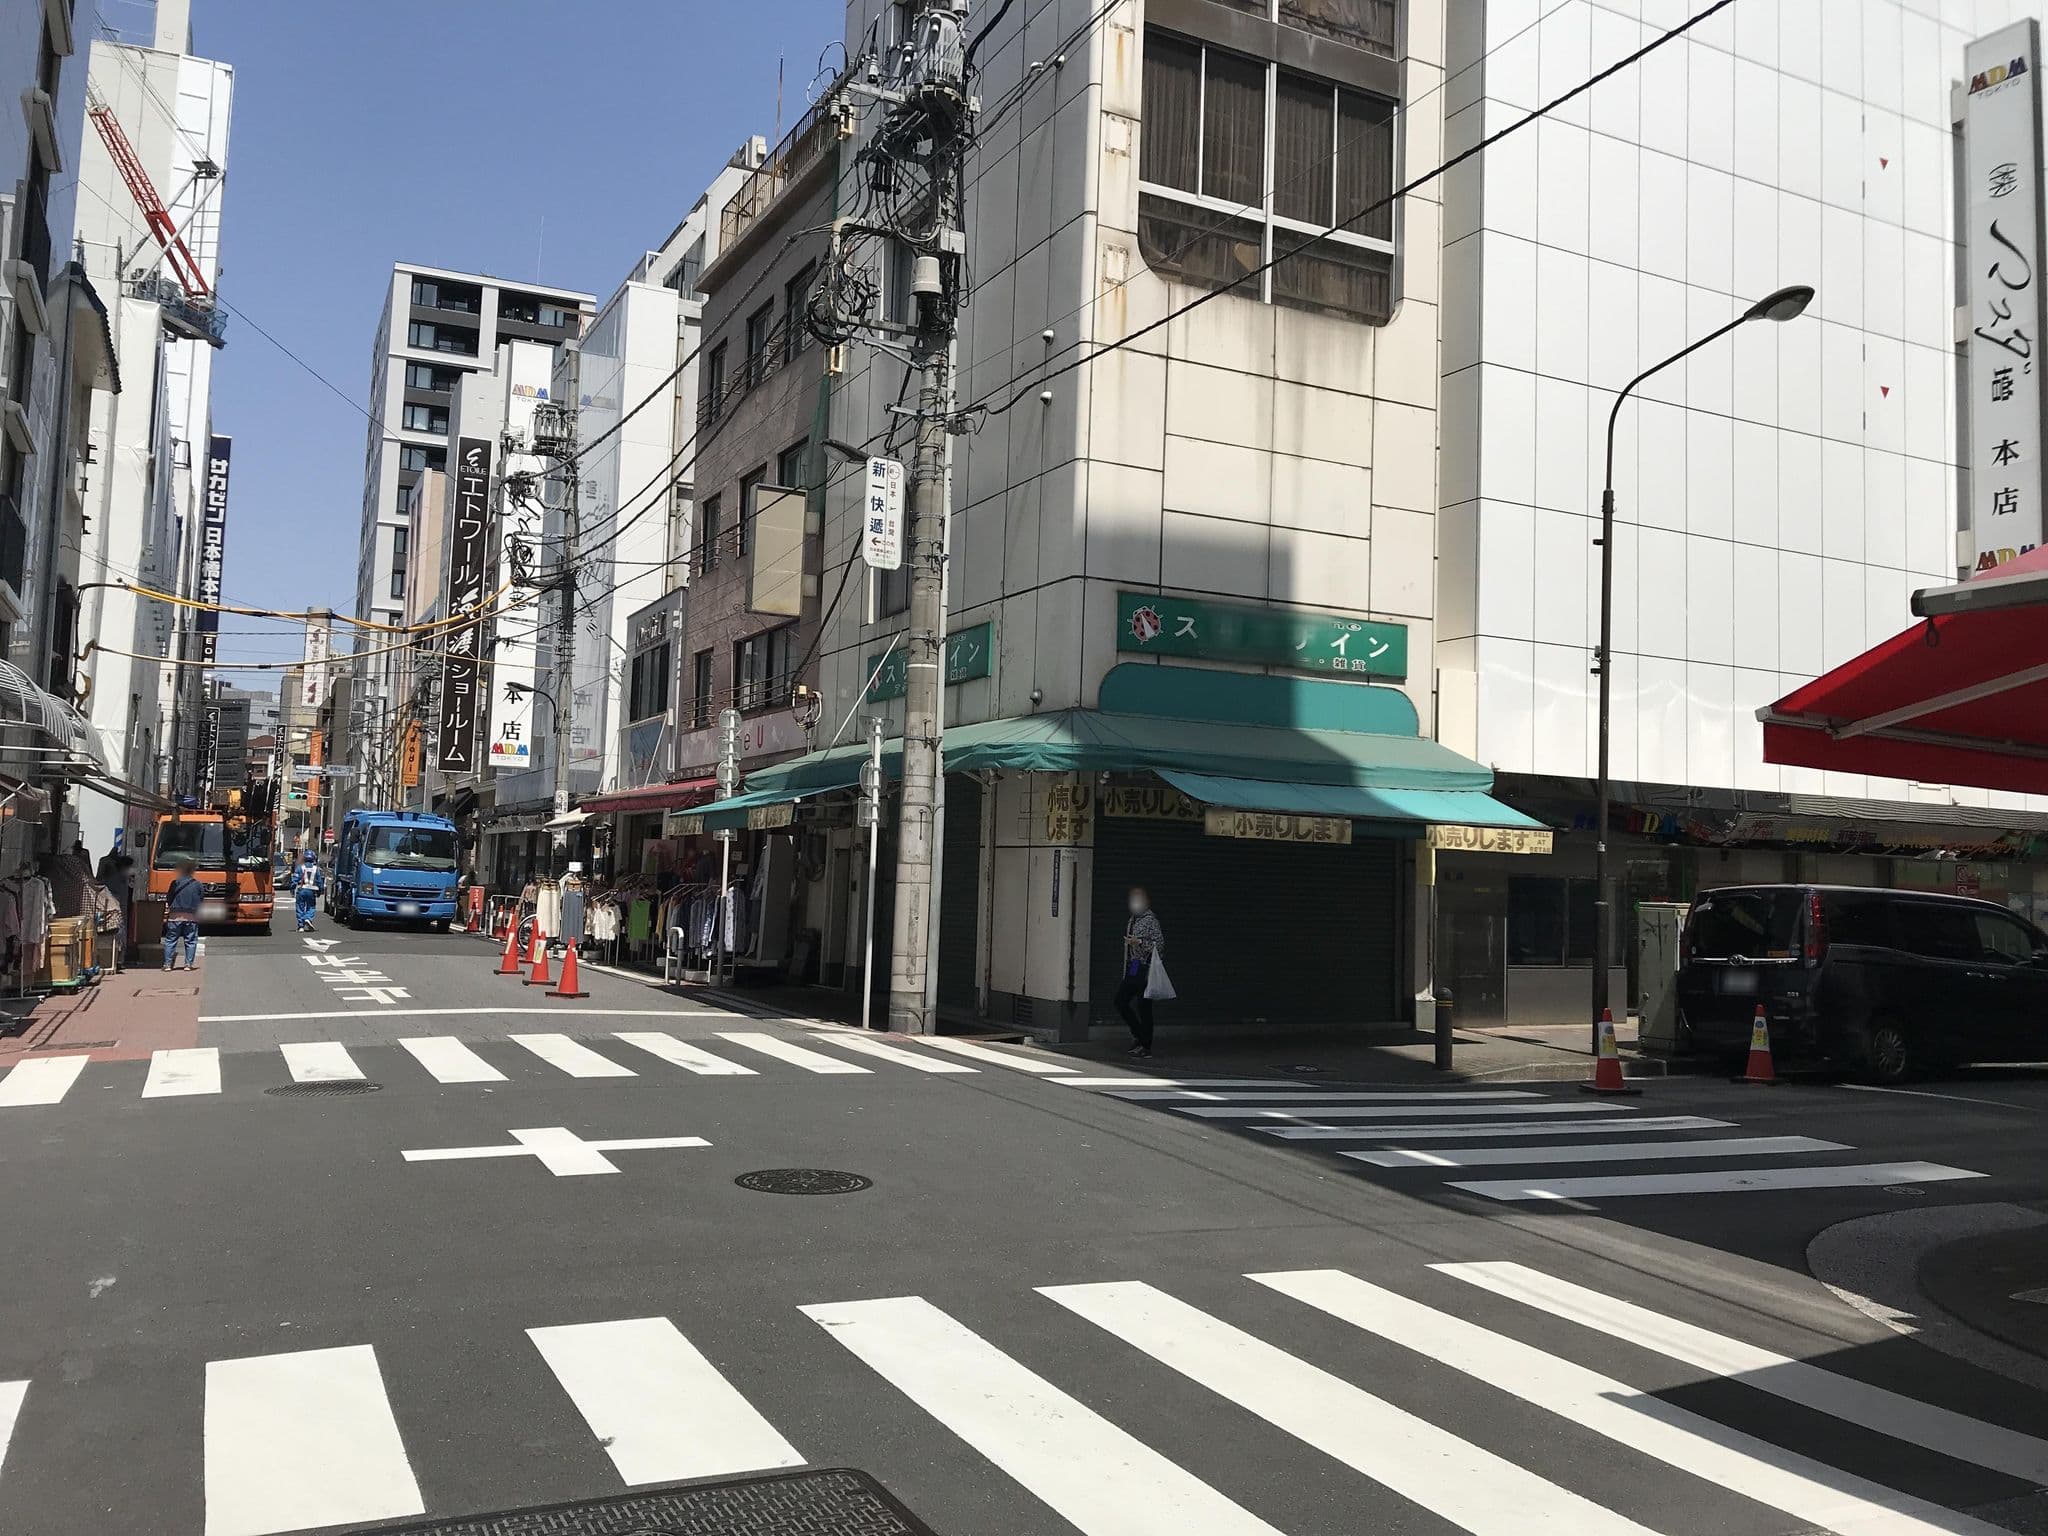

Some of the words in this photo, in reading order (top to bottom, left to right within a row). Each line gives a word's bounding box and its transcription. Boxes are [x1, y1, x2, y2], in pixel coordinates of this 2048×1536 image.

[1428, 826, 1529, 852] 小売りします
